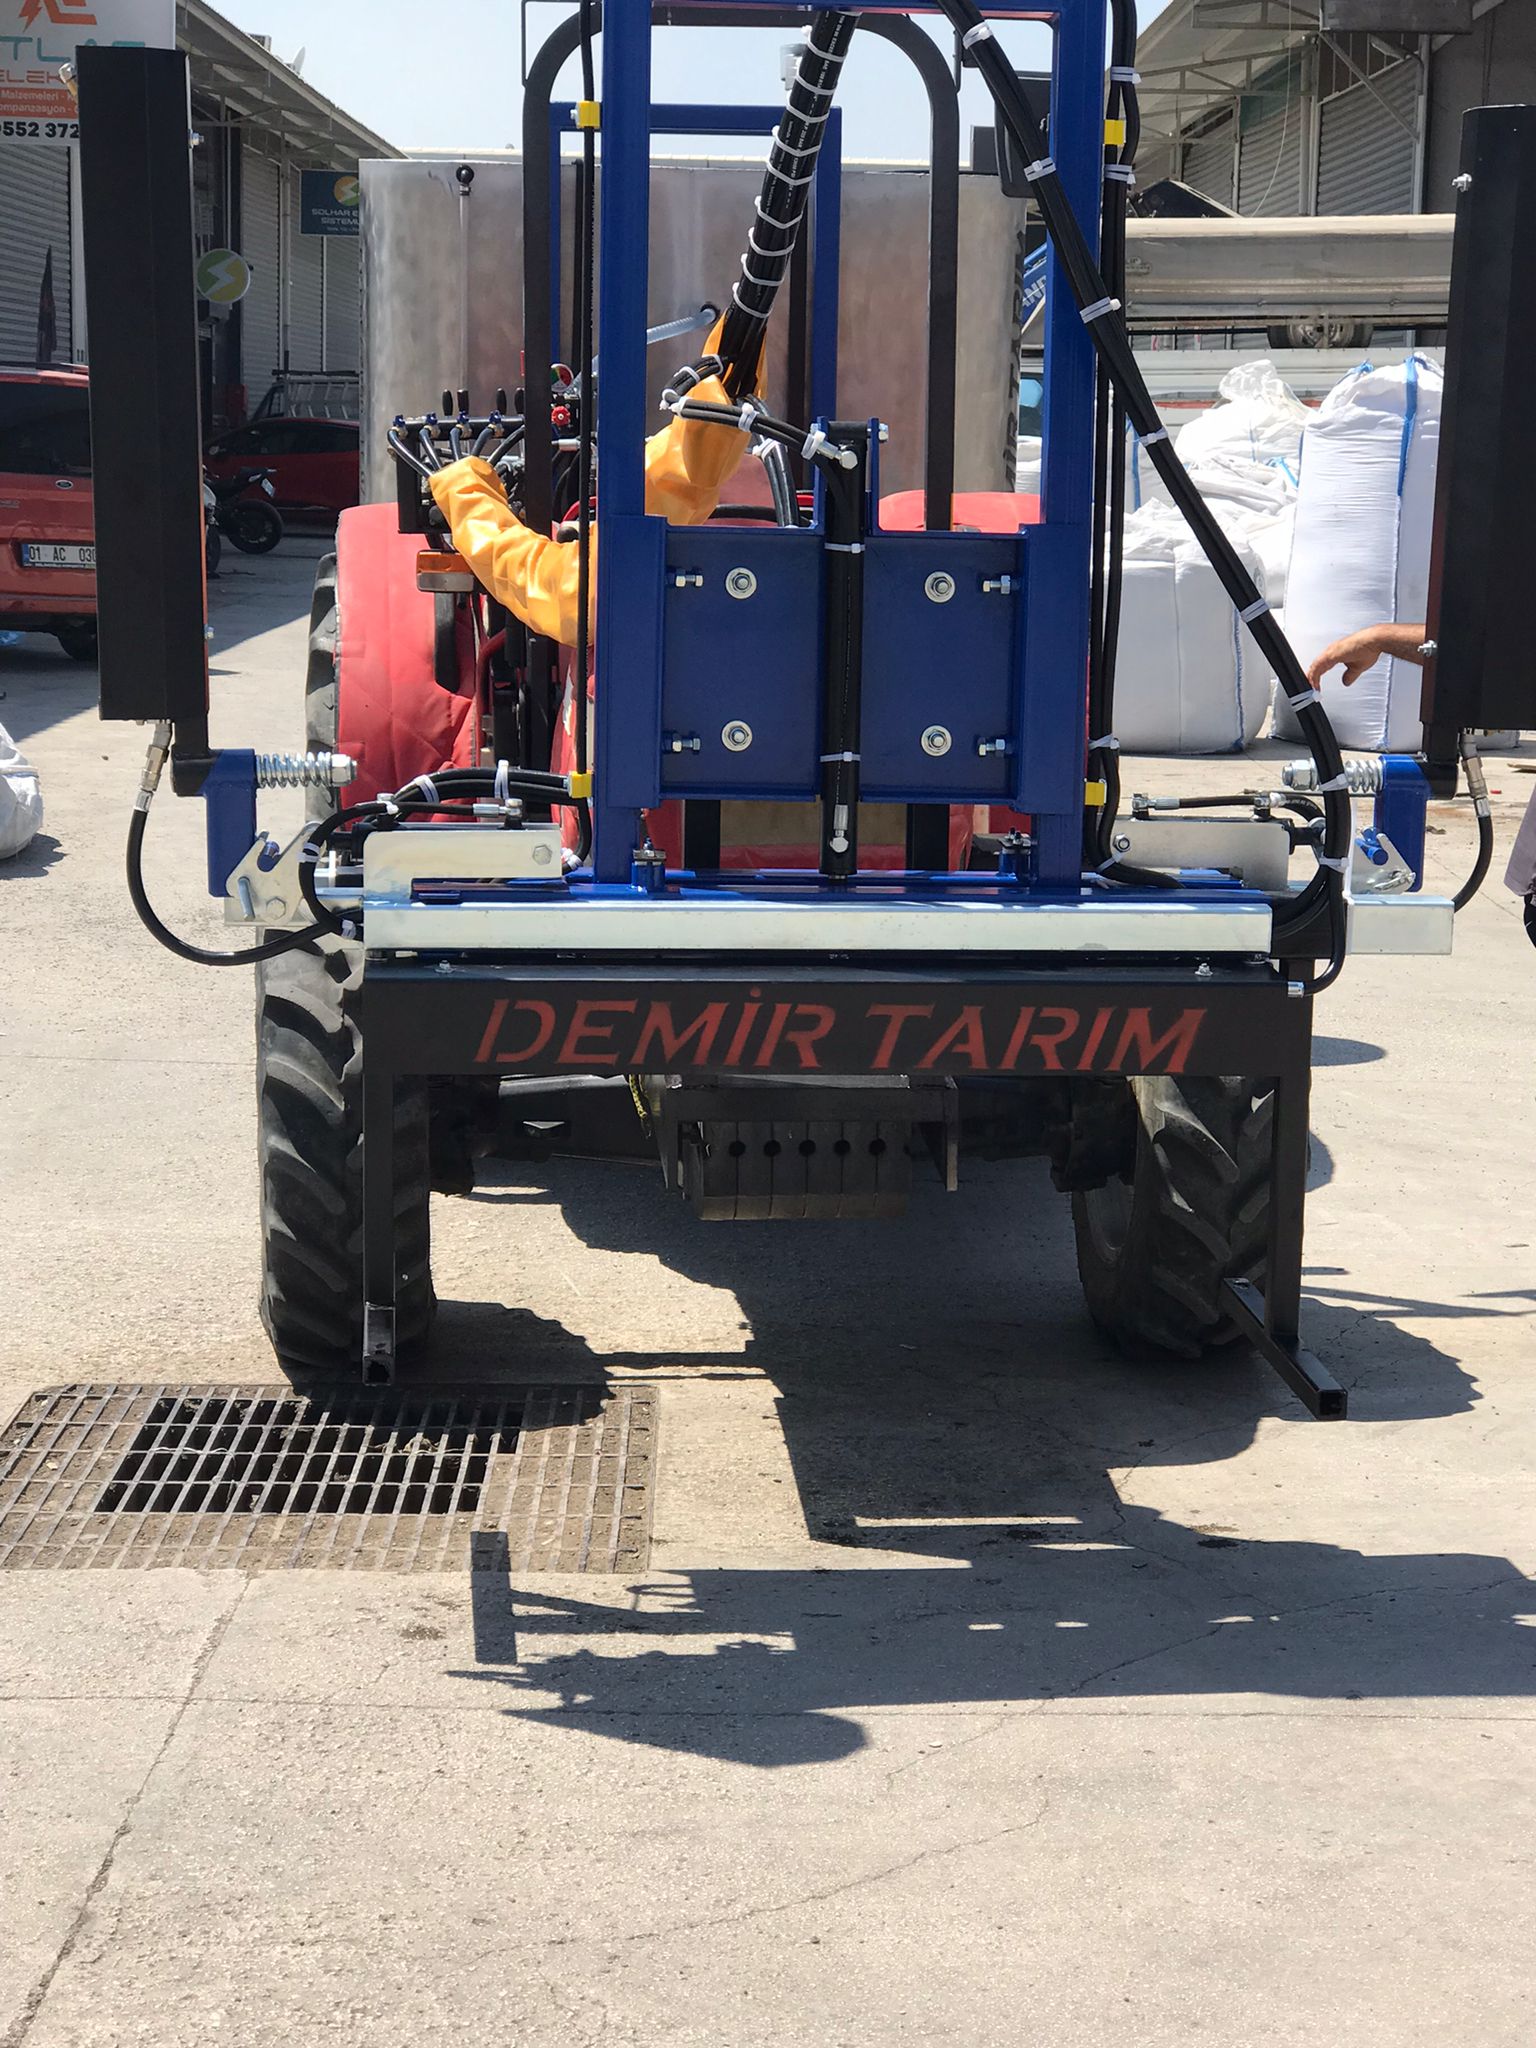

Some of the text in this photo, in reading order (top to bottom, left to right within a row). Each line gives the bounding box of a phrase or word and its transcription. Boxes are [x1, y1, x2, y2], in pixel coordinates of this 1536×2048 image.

[29, 545, 41, 560] 01
[53, 546, 66, 561] AC
[473, 986, 1207, 1074] DEMİR TARIM
